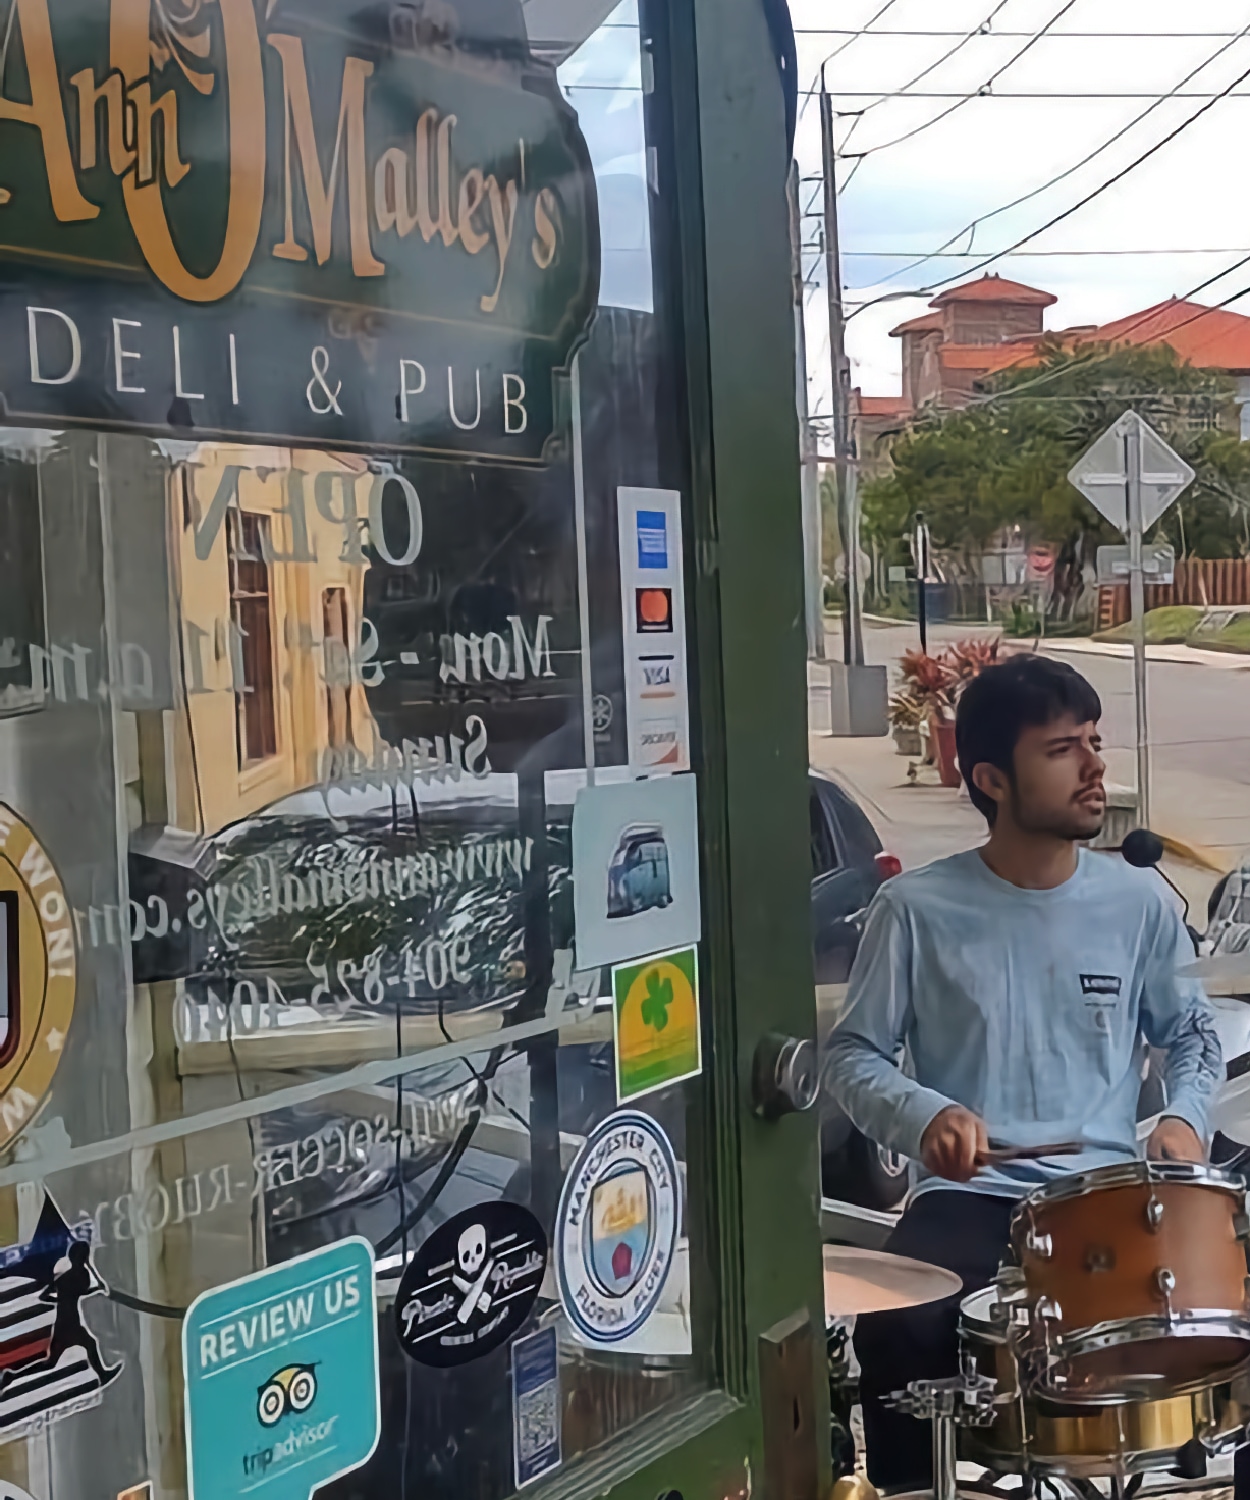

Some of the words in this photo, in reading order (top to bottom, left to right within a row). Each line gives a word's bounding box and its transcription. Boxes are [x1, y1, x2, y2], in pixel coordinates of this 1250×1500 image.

[26, 305, 240, 406] DELI
[305, 345, 344, 417] &
[399, 358, 528, 435] PUB
[200, 1291, 315, 1368] REVIEW
[324, 1274, 360, 1315] US
[242, 1414, 340, 1477] tripadvisor
